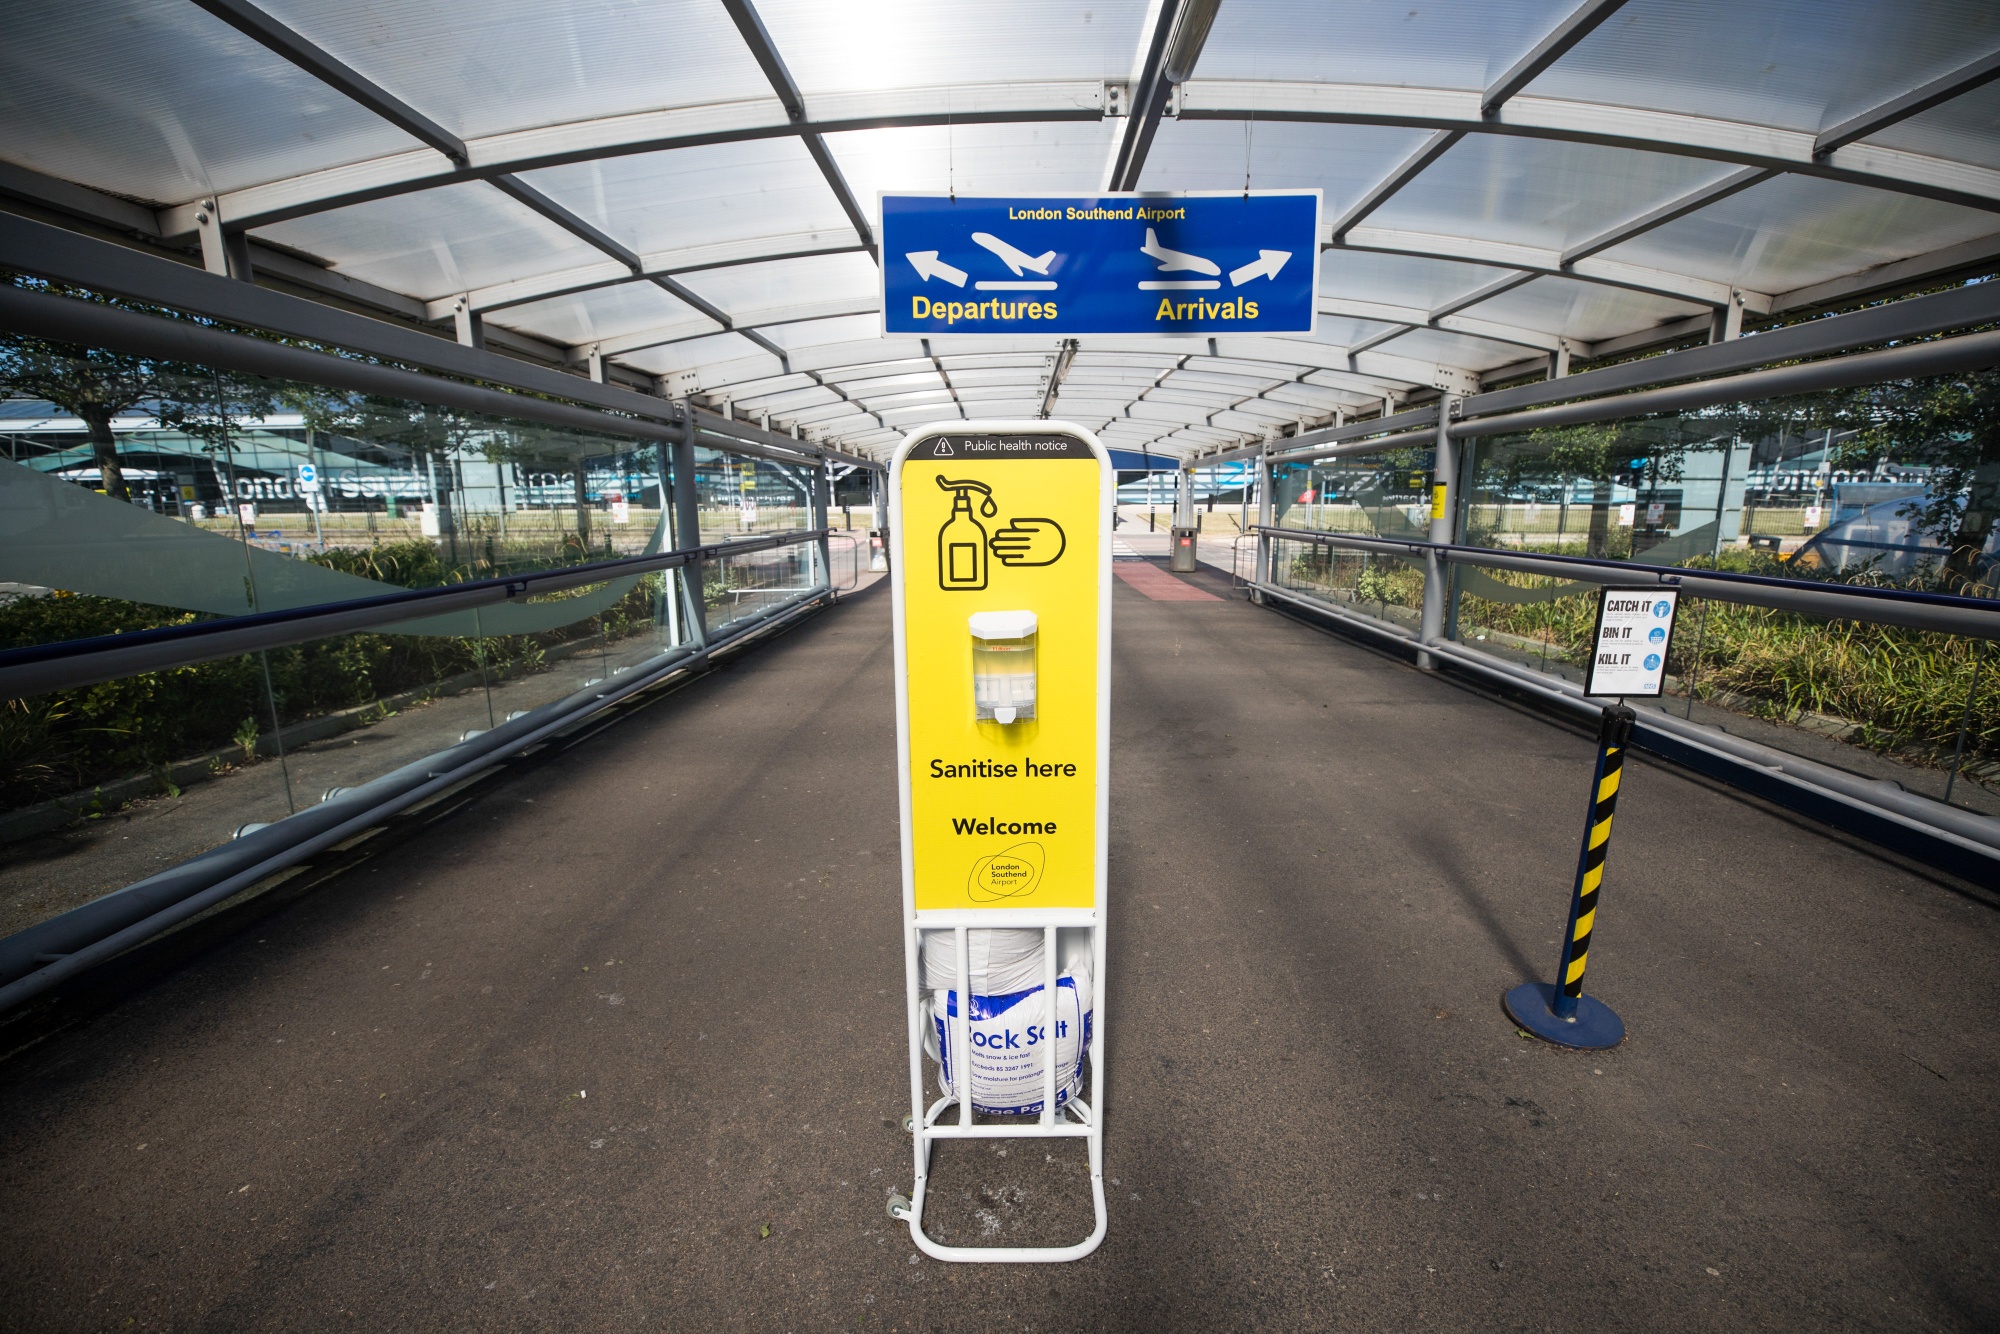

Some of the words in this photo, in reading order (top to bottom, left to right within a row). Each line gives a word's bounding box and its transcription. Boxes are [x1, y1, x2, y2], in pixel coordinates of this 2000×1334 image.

[1009, 207, 1062, 220] London
[1066, 207, 1133, 220] Southend
[1136, 207, 1185, 222] Airport
[912, 295, 1058, 325] Departures
[1155, 296, 1259, 321] Arrivals
[964, 439, 997, 451] Public
[999, 439, 1032, 451] health
[1034, 439, 1068, 451] notice
[1607, 600, 1639, 612] CATCH
[1641, 600, 1652, 612] IT
[1602, 627, 1619, 638] BIN
[1621, 627, 1632, 638] IT
[1598, 654, 1618, 665] KILL
[1620, 654, 1631, 665] IT
[930, 758, 1018, 778] Sanitise
[1025, 757, 1077, 777] here
[951, 816, 1057, 835] Welcome
[969, 1025, 1020, 1049] ock
[983, 1074, 1009, 1082] moisture
[1019, 1069, 1044, 1081] prolonge
